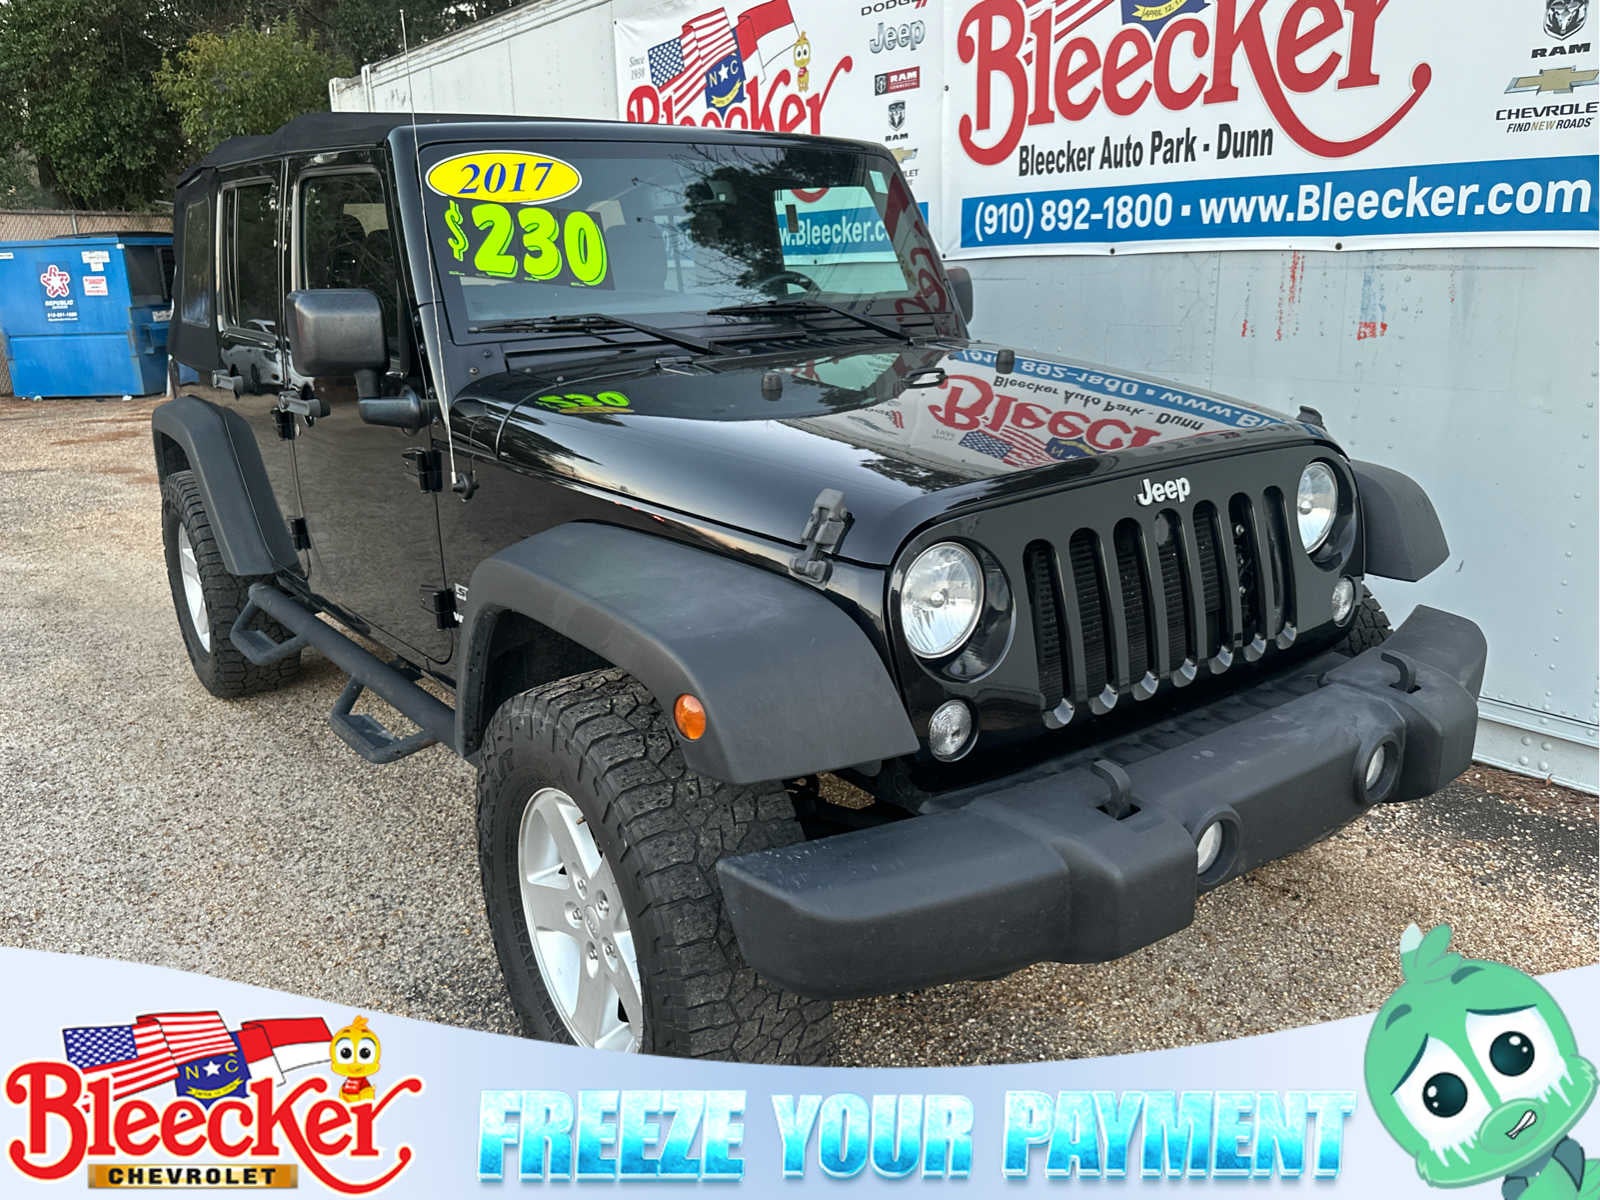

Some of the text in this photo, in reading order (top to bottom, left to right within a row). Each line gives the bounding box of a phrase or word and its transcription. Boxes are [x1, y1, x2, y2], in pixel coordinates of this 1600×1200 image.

[861, 0, 918, 16] DODG
[869, 20, 925, 54] Jeep
[1531, 43, 1591, 58] RAM
[709, 60, 739, 87] N C
[890, 71, 918, 83] RAM
[956, 0, 1432, 166] Bleecker
[627, 55, 853, 135] Blcker
[1496, 102, 1600, 120] CHEVROLE
[885, 133, 909, 142] RAM
[1018, 140, 1095, 176] Bleecker
[1099, 135, 1143, 170] Auto
[1150, 127, 1197, 165] Park
[1216, 123, 1273, 159] Dunn
[458, 163, 554, 194] 2017
[974, 176, 1592, 242] (910) 892-1800 www.Bleecker.com
[444, 200, 608, 286] $230
[1137, 477, 1190, 506] Jeep
